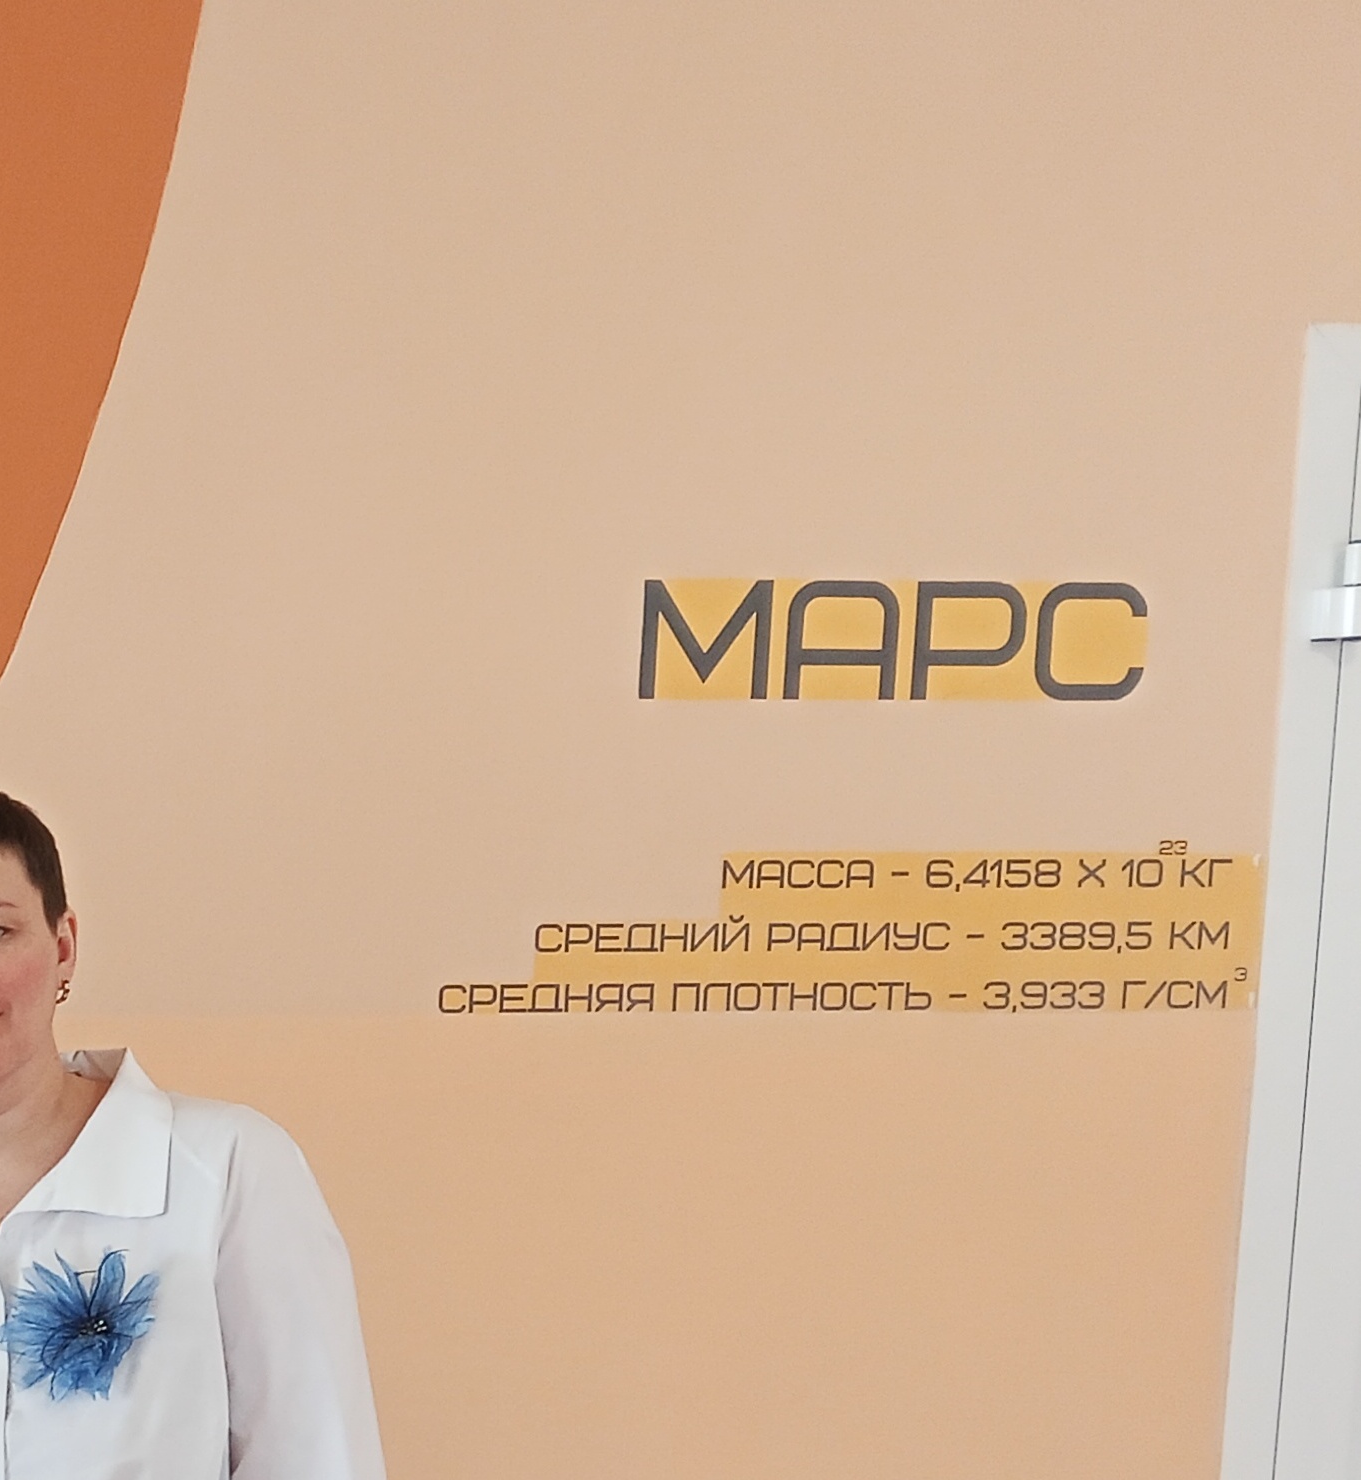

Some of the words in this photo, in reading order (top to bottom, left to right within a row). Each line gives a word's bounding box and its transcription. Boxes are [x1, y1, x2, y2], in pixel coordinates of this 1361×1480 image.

[638, 579, 1148, 701] МАРС
[721, 859, 875, 889] МАССА
[925, 858, 1063, 892] 6,4158
[1179, 858, 1234, 888] КГ
[534, 914, 751, 953] СРЕДНИЙ
[766, 921, 952, 953] РАДИУС
[1000, 921, 1153, 954] 3389,5
[1168, 920, 1231, 950] КМ
[438, 982, 655, 1015] СРЕДНЯЯ
[671, 981, 933, 1012] ПЛОТНОСТЬ
[982, 980, 1106, 1013] 3,933
